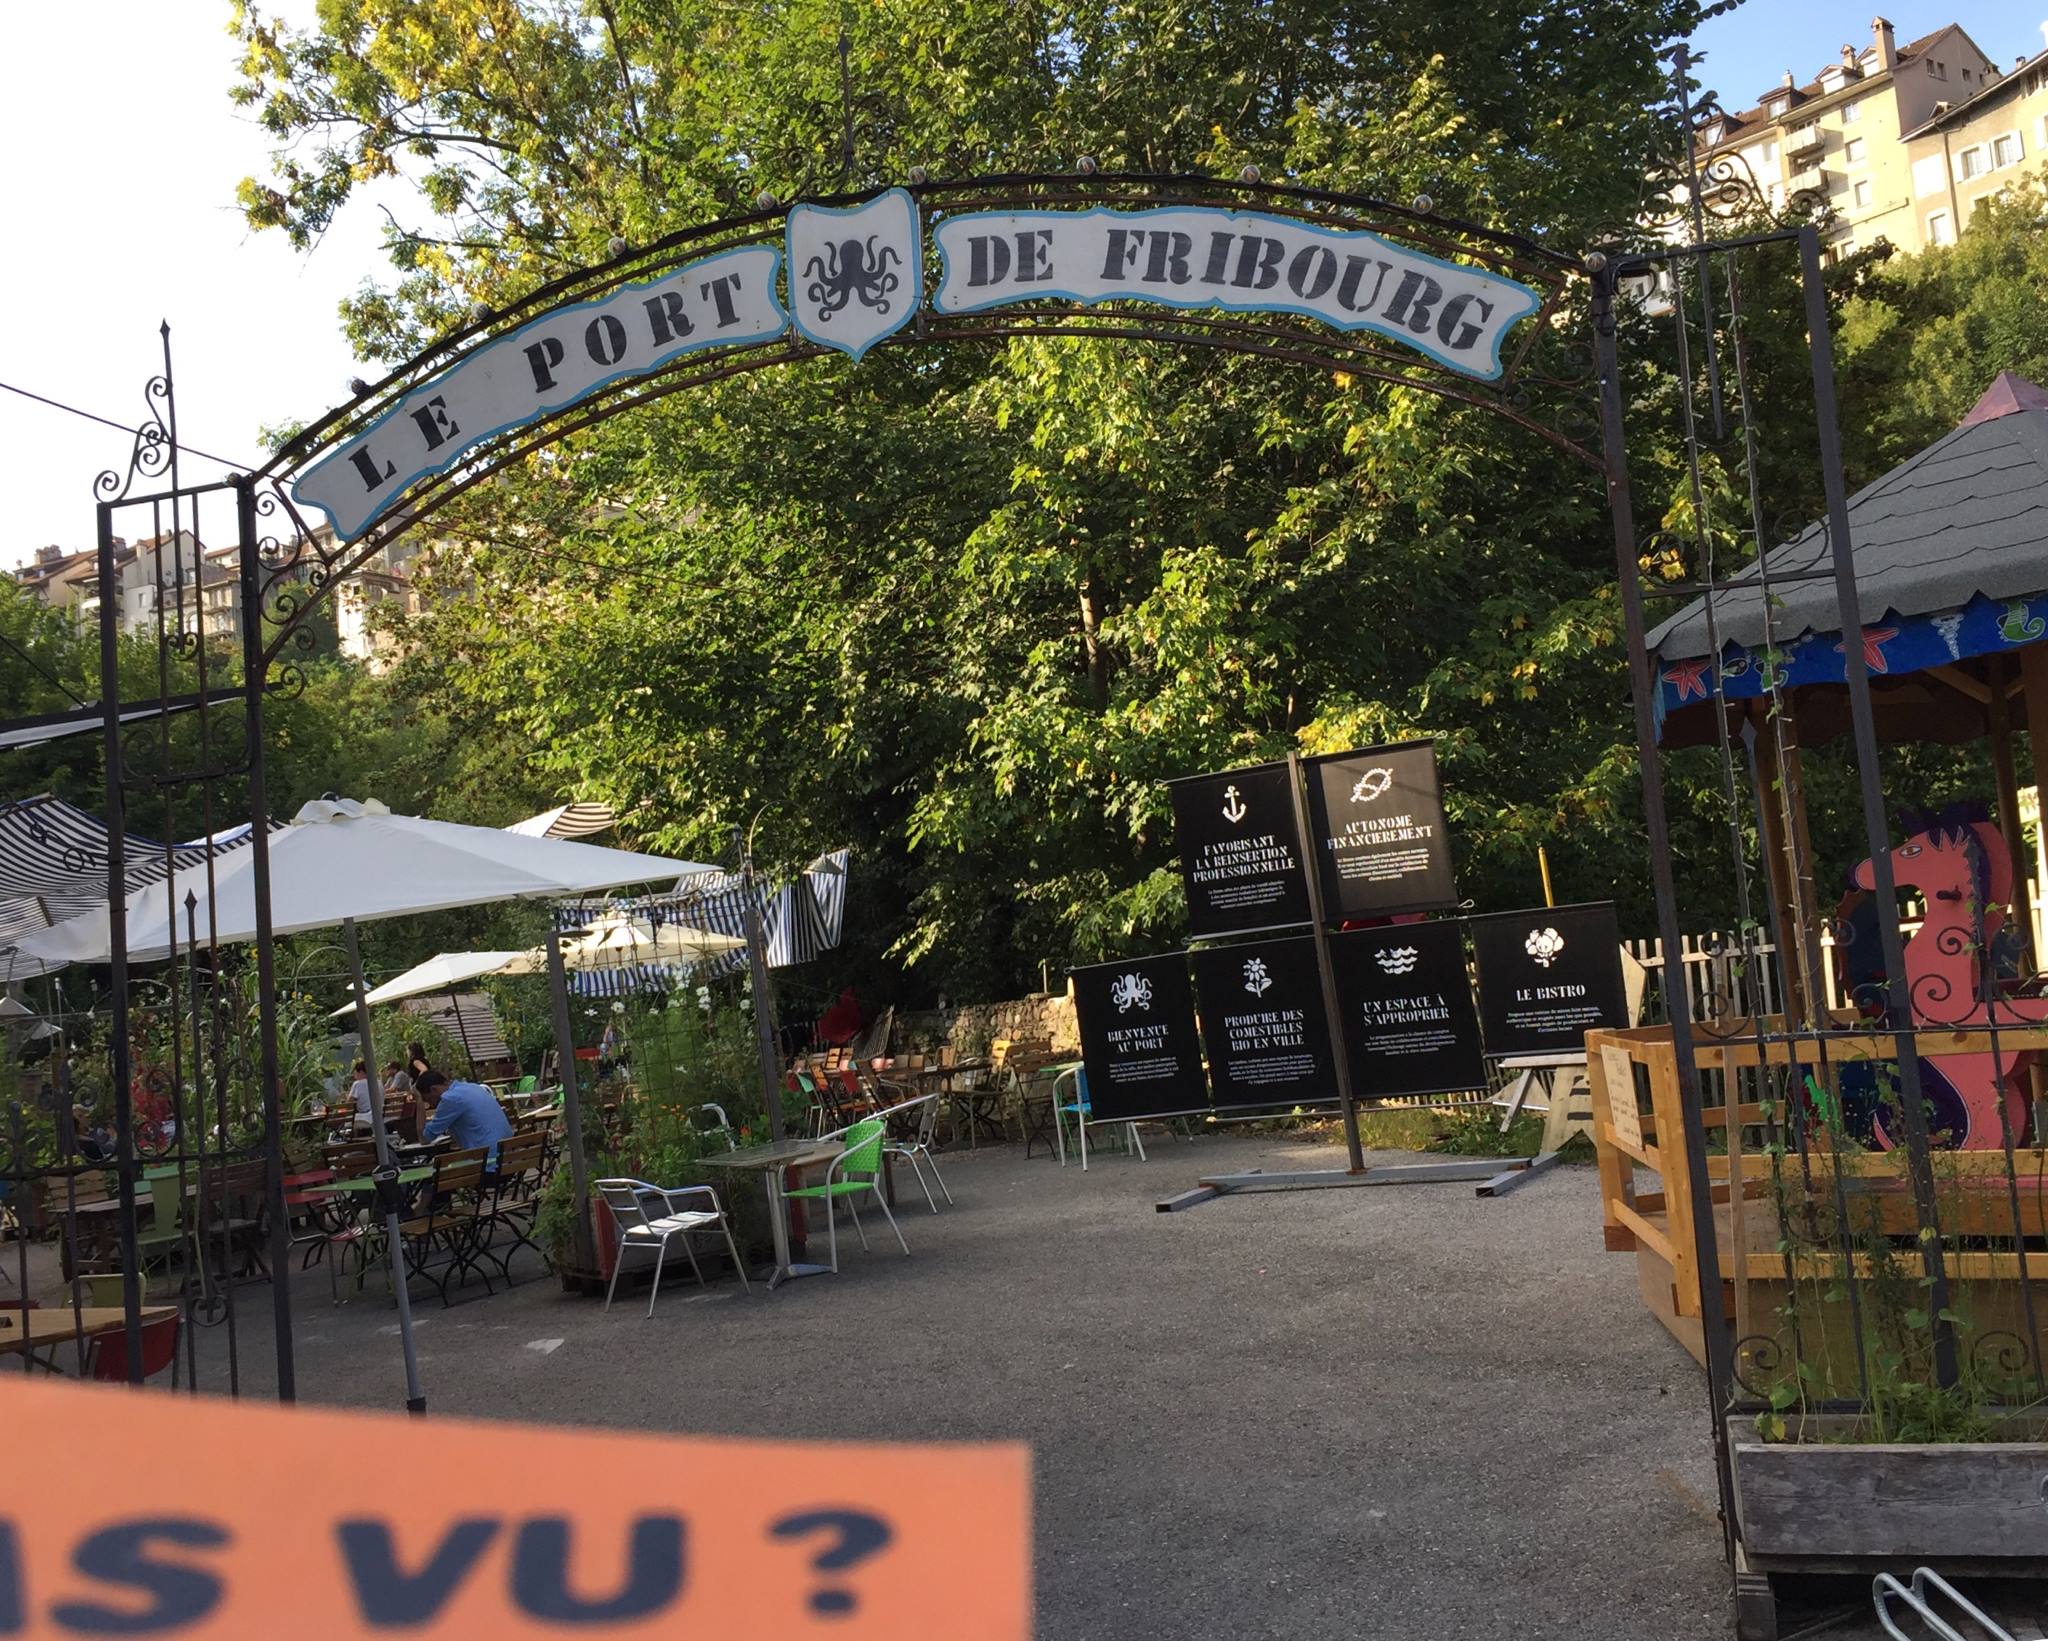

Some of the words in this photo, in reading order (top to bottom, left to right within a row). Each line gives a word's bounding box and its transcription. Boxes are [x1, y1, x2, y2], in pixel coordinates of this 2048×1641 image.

[966, 229, 1054, 287] DE
[1099, 229, 1495, 350] FRIBOURG
[349, 395, 461, 494] LE
[522, 273, 743, 394] PORT
[1345, 814, 1413, 835] AUTONOME
[1204, 835, 1275, 857] FAVORISANT
[1327, 825, 1433, 850] FINANCIEREMENT
[1196, 858, 1210, 870] LA
[1213, 845, 1288, 868] REINSERTION
[1193, 857, 1296, 883] PROFESSIONNELLE
[1516, 988, 1532, 1001] LE
[1536, 984, 1586, 1000] BISTRO
[1363, 1000, 1381, 1014] UN
[1385, 995, 1432, 1011] ESPACE
[1224, 1011, 1280, 1028] PRODUIRE
[1282, 1009, 1304, 1021] DES
[1363, 1007, 1450, 1027] S'APPROPRIER
[1107, 1024, 1169, 1043] BIENVENUE
[1229, 1021, 1304, 1039] COMESTIBLES
[1117, 1041, 1131, 1053] AU
[1134, 1037, 1164, 1051] PORT
[1231, 1040, 1251, 1052] BIO
[1253, 1037, 1269, 1049] EN
[1272, 1033, 1305, 1048] VILLE
[332, 1510, 690, 1632] VU
[766, 1508, 896, 1620] ?
